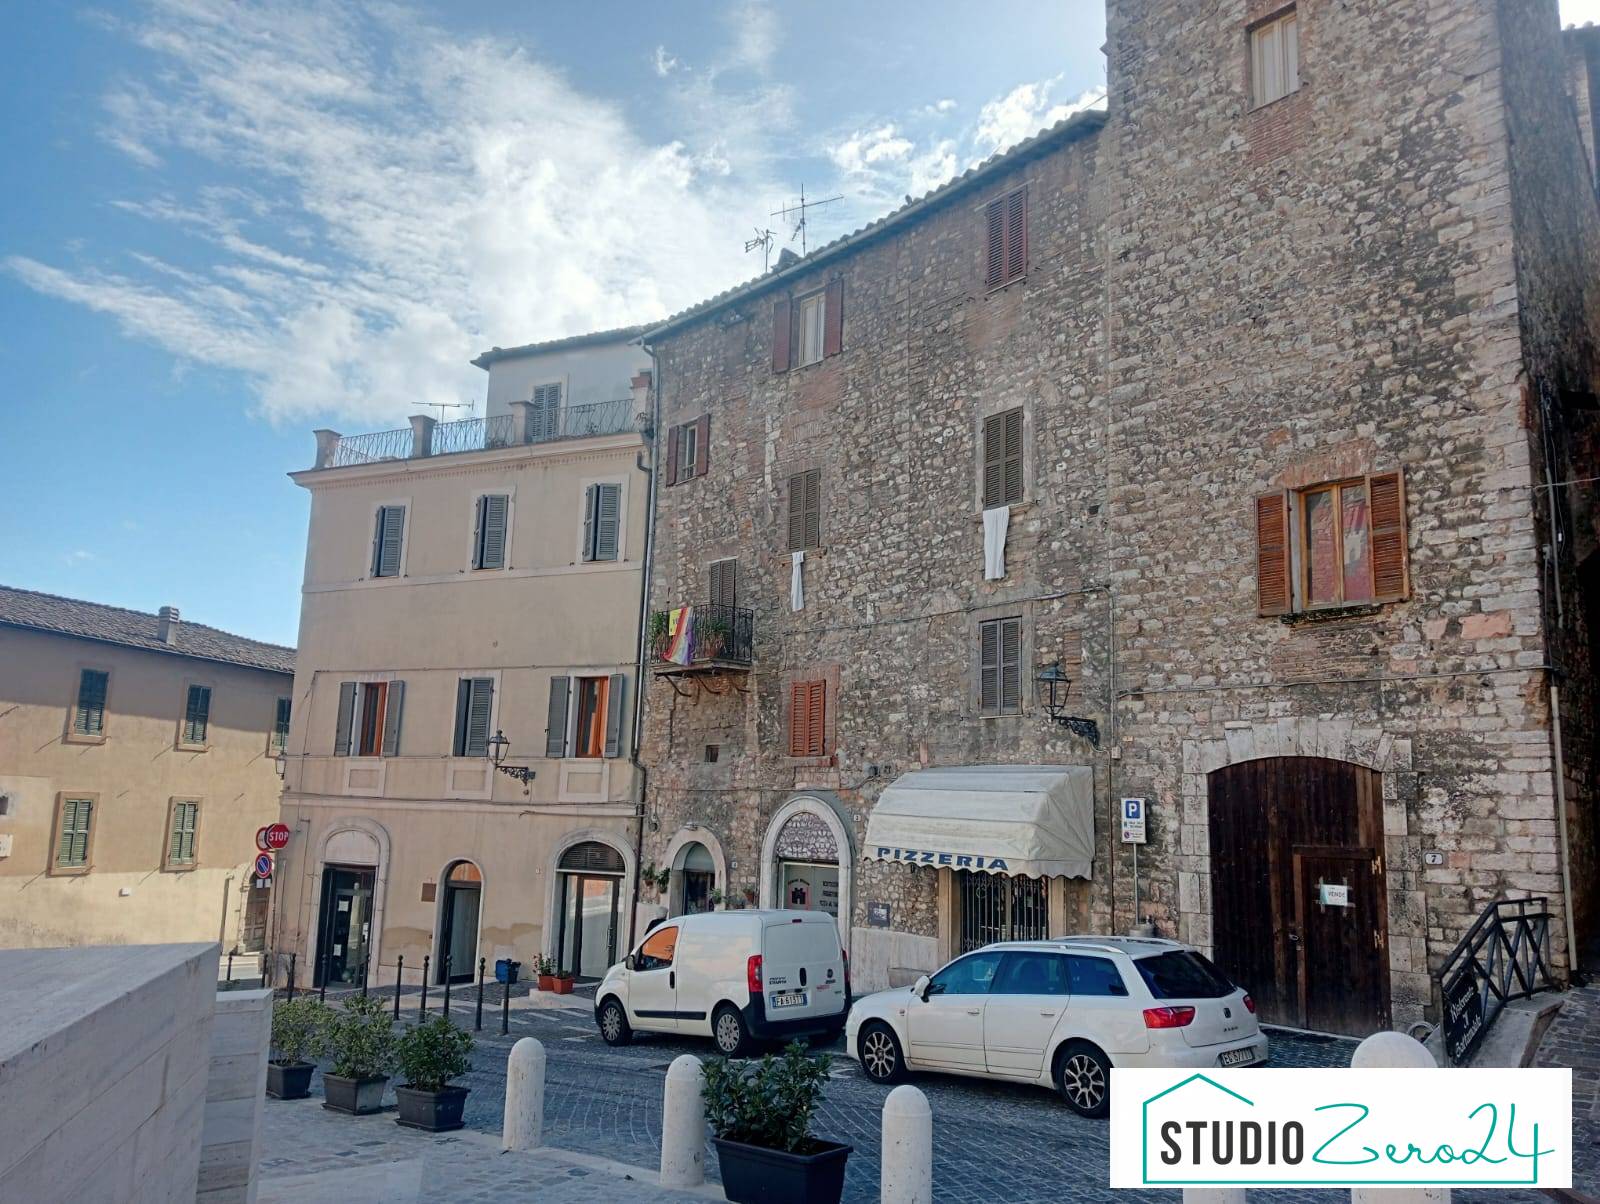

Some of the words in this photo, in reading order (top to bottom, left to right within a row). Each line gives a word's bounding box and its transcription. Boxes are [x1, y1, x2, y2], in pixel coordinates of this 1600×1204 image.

[1128, 802, 1138, 817] P
[269, 831, 289, 842] STOP
[877, 847, 1009, 872] PIZZERIA
